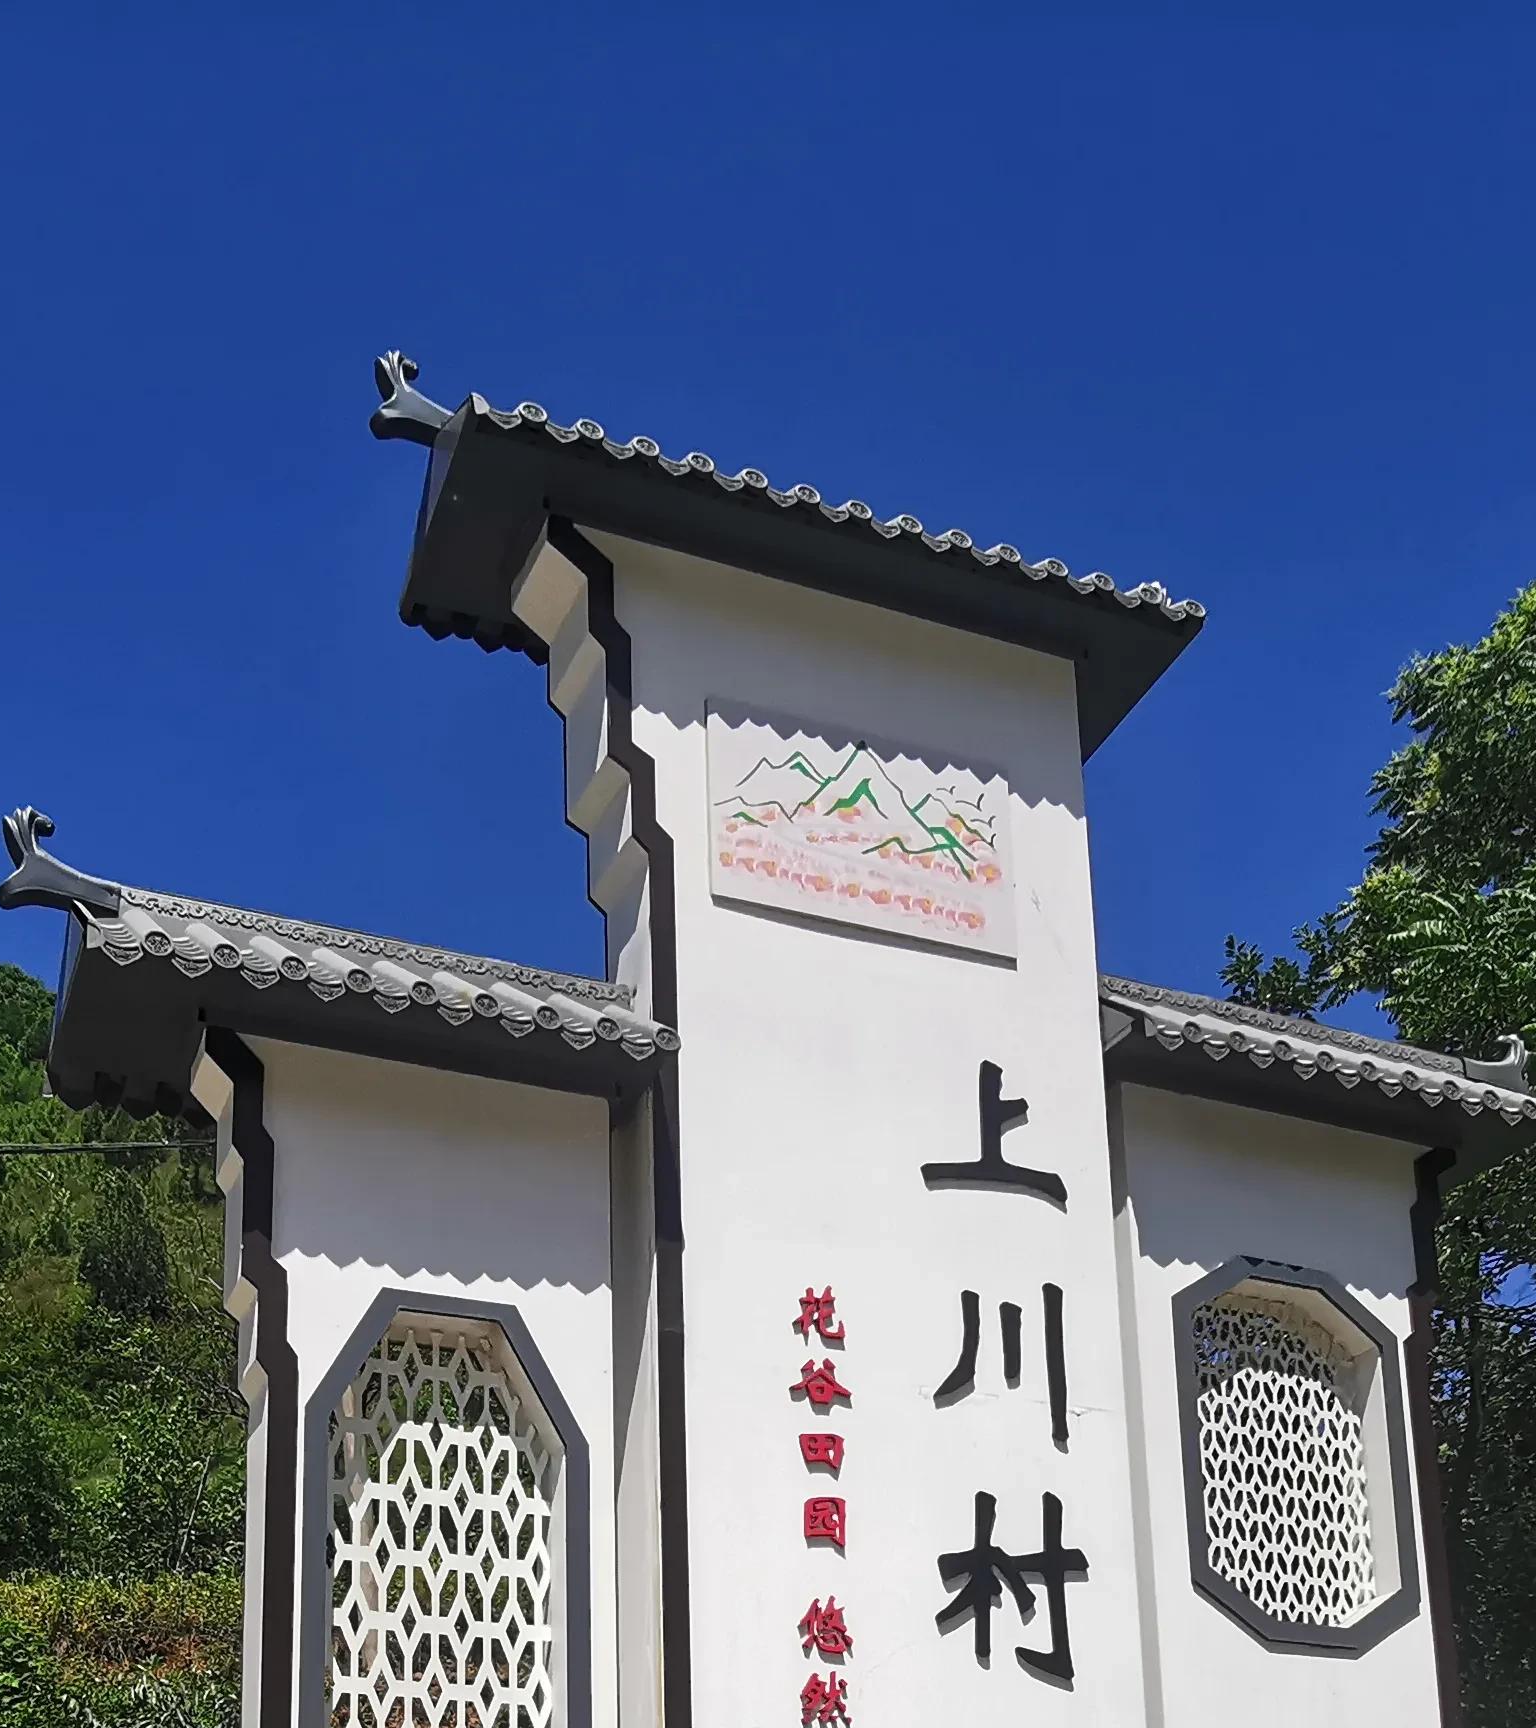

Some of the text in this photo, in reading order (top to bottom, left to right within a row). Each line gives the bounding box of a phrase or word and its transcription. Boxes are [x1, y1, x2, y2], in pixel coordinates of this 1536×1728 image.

[792, 1286, 852, 1550] 花谷田园
[920, 1060, 1090, 1688] 上川村
